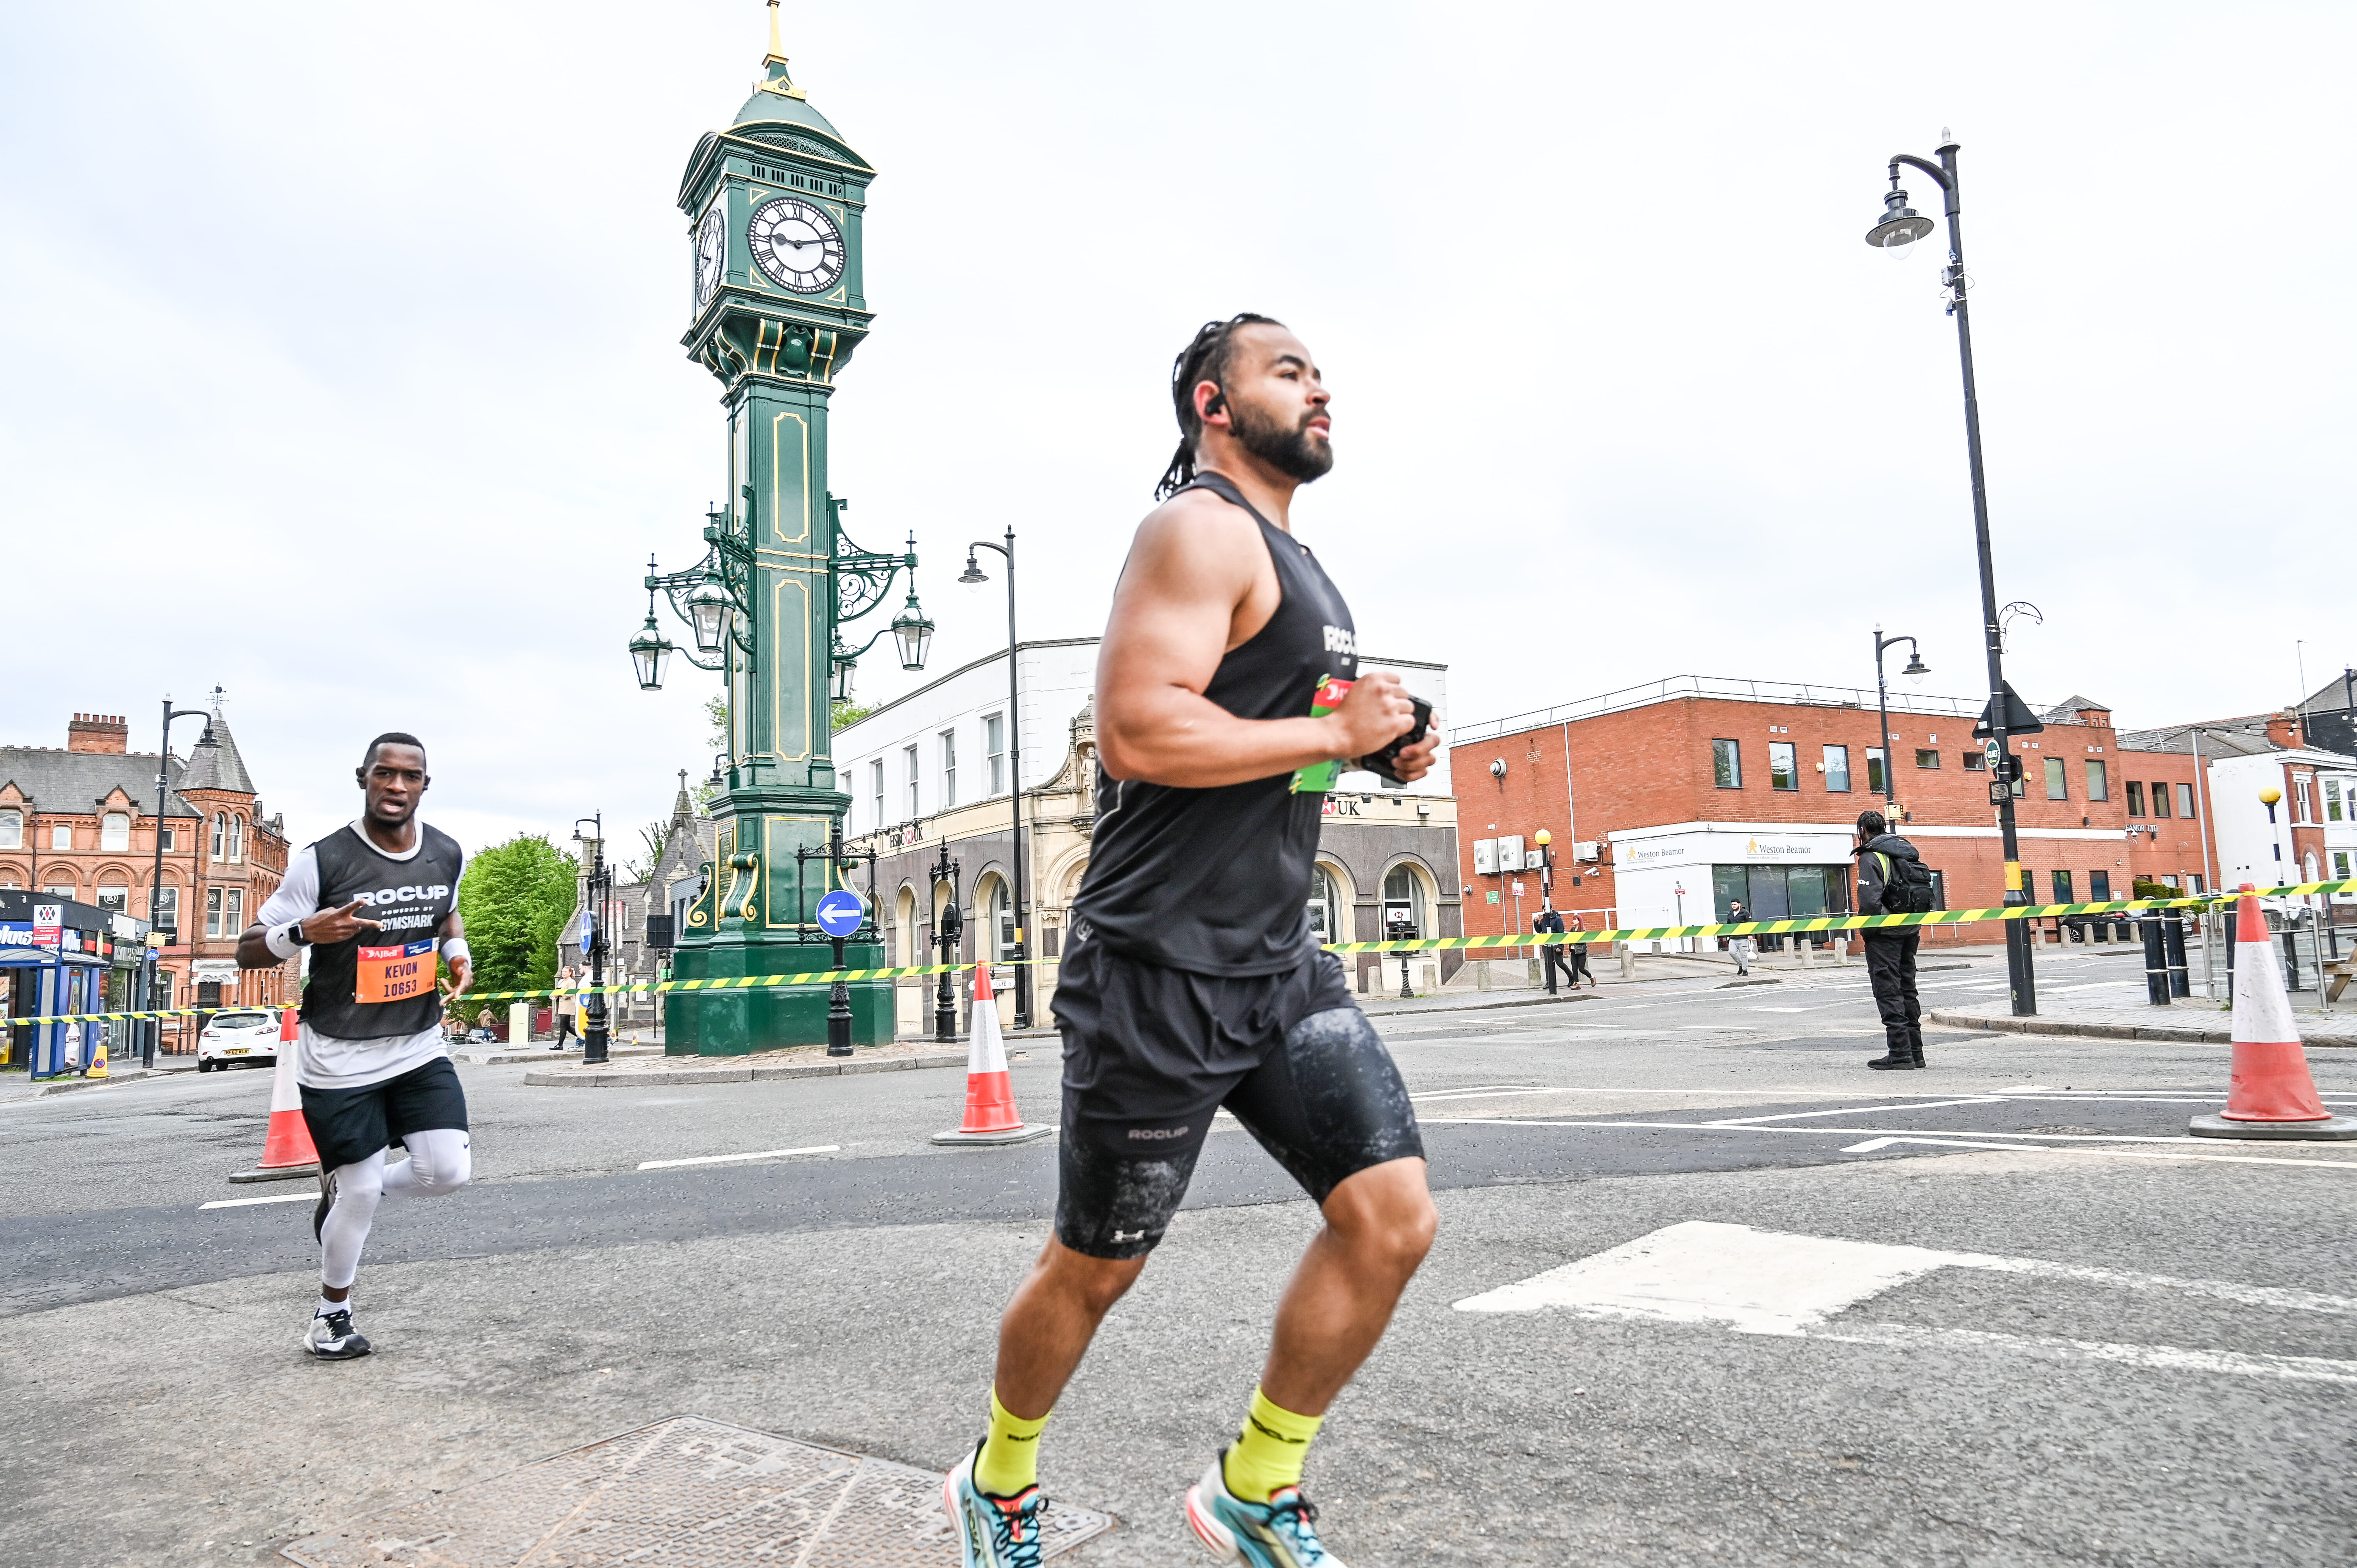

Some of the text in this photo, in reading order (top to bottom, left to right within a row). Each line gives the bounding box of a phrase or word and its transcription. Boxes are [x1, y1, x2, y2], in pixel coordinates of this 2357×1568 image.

[1337, 801, 1360, 815] UK
[890, 827, 923, 848] HSBC UK
[1760, 845, 1811, 853] Weston Beamor
[353, 885, 449, 907] ROCUP
[381, 906, 420, 916] POWERED
[380, 914, 435, 932] GYMSHARK
[385, 961, 418, 978] KEVON
[384, 980, 417, 997] 10653
[1128, 1126, 1189, 1140] ROCUP
